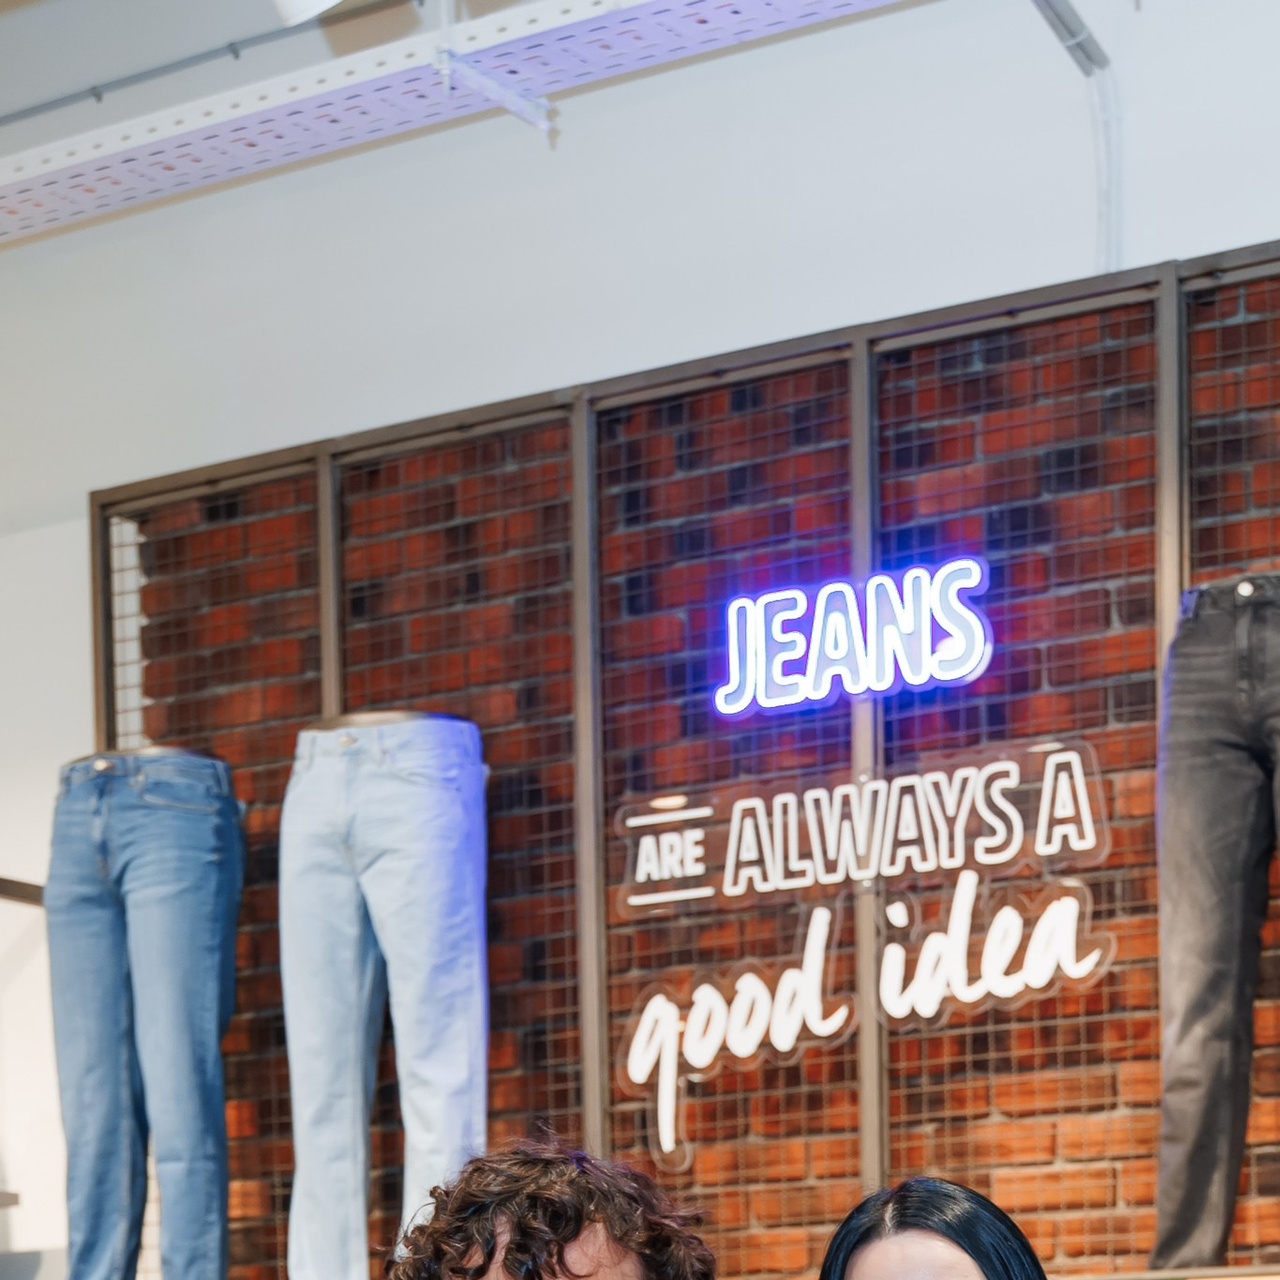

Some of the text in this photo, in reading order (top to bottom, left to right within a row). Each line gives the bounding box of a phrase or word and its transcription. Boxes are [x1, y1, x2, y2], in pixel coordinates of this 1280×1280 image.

[714, 557, 991, 716] JEANS
[635, 751, 1097, 897] ARE ALWAYS A
[627, 870, 1101, 1154] good idea
